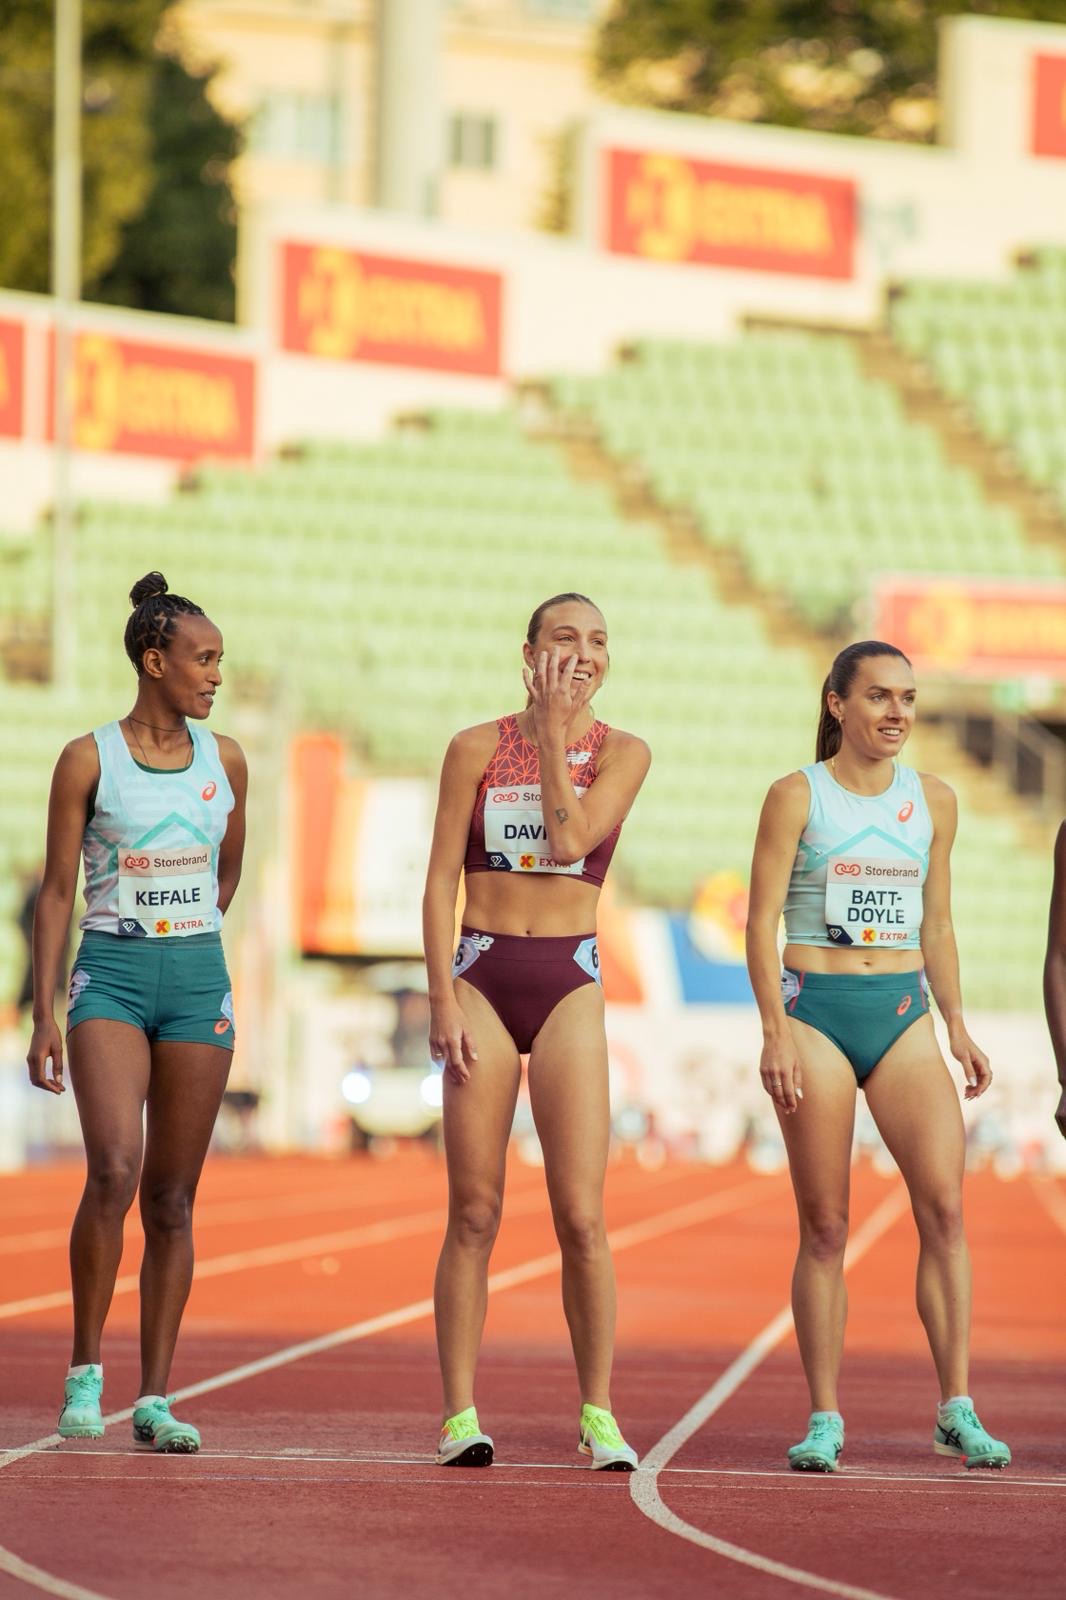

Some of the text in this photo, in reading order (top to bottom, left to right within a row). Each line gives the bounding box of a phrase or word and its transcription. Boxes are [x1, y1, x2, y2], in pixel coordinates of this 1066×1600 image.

[504, 824, 547, 840] DAVI
[153, 853, 208, 868] Storebrand
[865, 865, 919, 878] Storebrand
[135, 887, 201, 906] KEFALE
[851, 889, 902, 906] BATT-
[847, 907, 905, 924] DOYLE
[173, 919, 204, 931] EXTRA
[879, 932, 908, 941] EXTRA
[591, 944, 599, 969] 6
